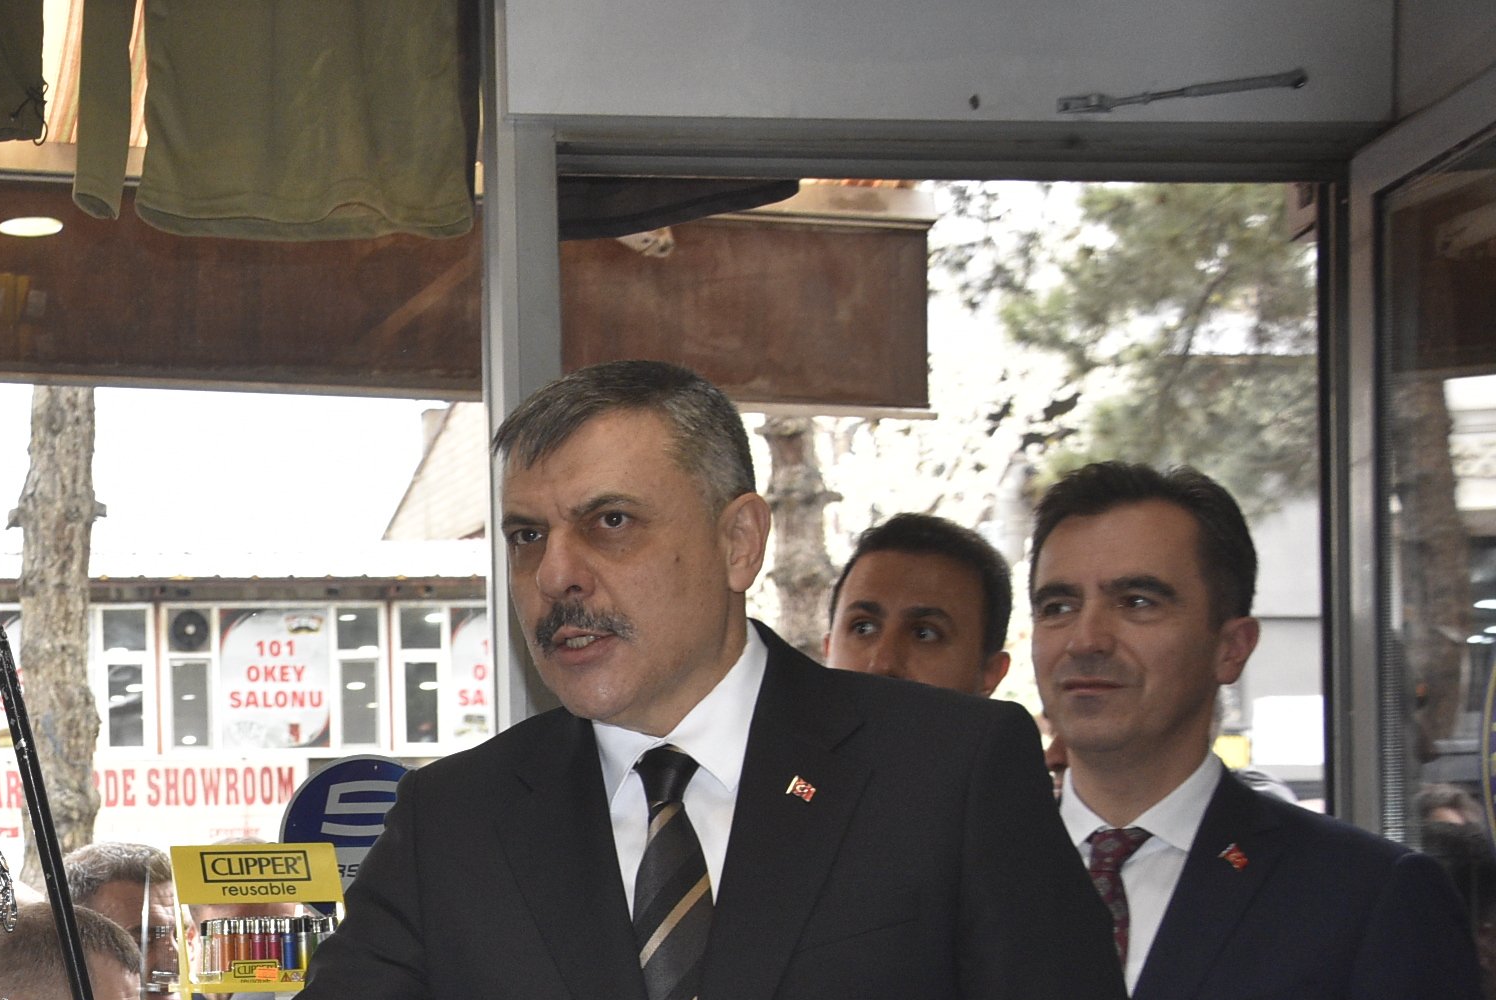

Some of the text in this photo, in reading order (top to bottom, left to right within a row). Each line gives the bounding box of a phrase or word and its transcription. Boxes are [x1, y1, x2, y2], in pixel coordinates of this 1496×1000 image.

[256, 640, 295, 657] 101
[246, 665, 306, 682] OKEY
[229, 690, 323, 709] SALONU
[147, 765, 295, 807] SHOWROOM
[210, 856, 301, 877] CLIPPER
[221, 882, 297, 897] reusable
[237, 963, 275, 975] CLIP
